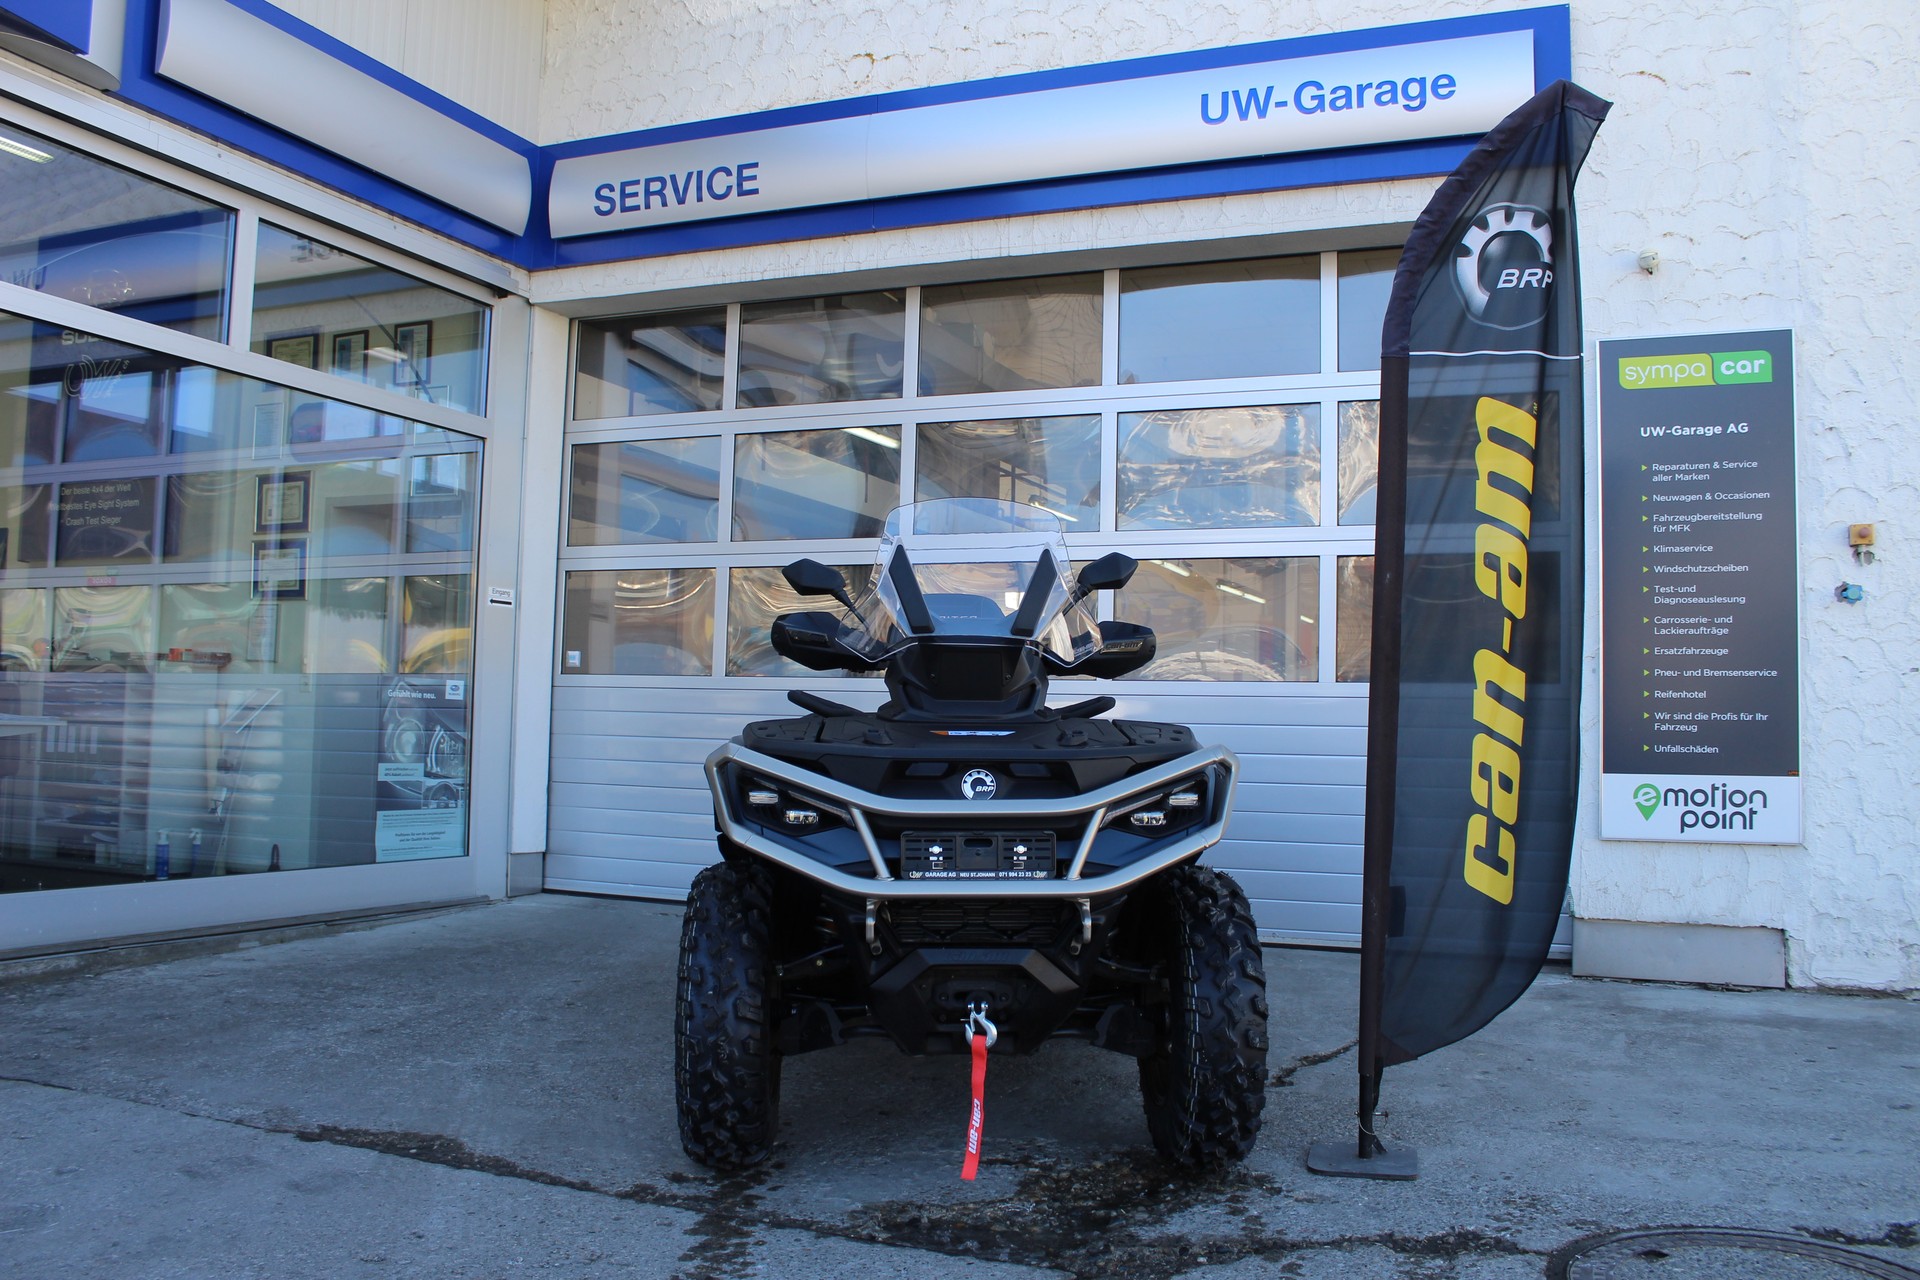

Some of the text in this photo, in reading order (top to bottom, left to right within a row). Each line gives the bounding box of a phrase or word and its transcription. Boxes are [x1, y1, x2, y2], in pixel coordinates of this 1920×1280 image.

[1200, 73, 1457, 125] UW-Garage
[594, 162, 760, 216] SERVICE
[1497, 268, 1553, 289] BRP
[1625, 359, 1765, 384] sympa car
[1641, 423, 1748, 437] UW-Garage AG
[1653, 462, 1710, 472] Reparaturen
[1723, 460, 1758, 469] Service
[1653, 472, 1709, 482] aller Marken
[1653, 493, 1702, 502] Neuwagen
[1715, 491, 1770, 500] Occasionen
[1653, 512, 1762, 522] Fahrzeugbereitstellung
[1669, 524, 1690, 532] MFK
[1653, 544, 1713, 553] Klimaservice
[1654, 564, 1748, 573] Windschutzscheiben
[492, 588, 511, 597] Eingang
[1654, 585, 1696, 593] Test-und
[1654, 595, 1746, 605] Diagnoseauslesung
[1654, 616, 1733, 624] Carrosserie- und
[1654, 626, 1729, 635] Lackieraufträge
[1463, 396, 1537, 905] can-am
[1654, 647, 1728, 656] Ersatzfahrzeuge
[1654, 669, 1681, 677] Pneu-
[1704, 669, 1777, 677] Bremsenservice
[1654, 690, 1706, 699] Reifenhotel
[1655, 712, 1670, 720] Wir
[1673, 712, 1692, 720] sind
[1756, 713, 1768, 721] Ihr
[1654, 723, 1697, 732] Fahrzeug
[1654, 745, 1718, 753] Unfallschäden
[1680, 807, 1758, 833] point
[968, 1098, 982, 1155] can-am
